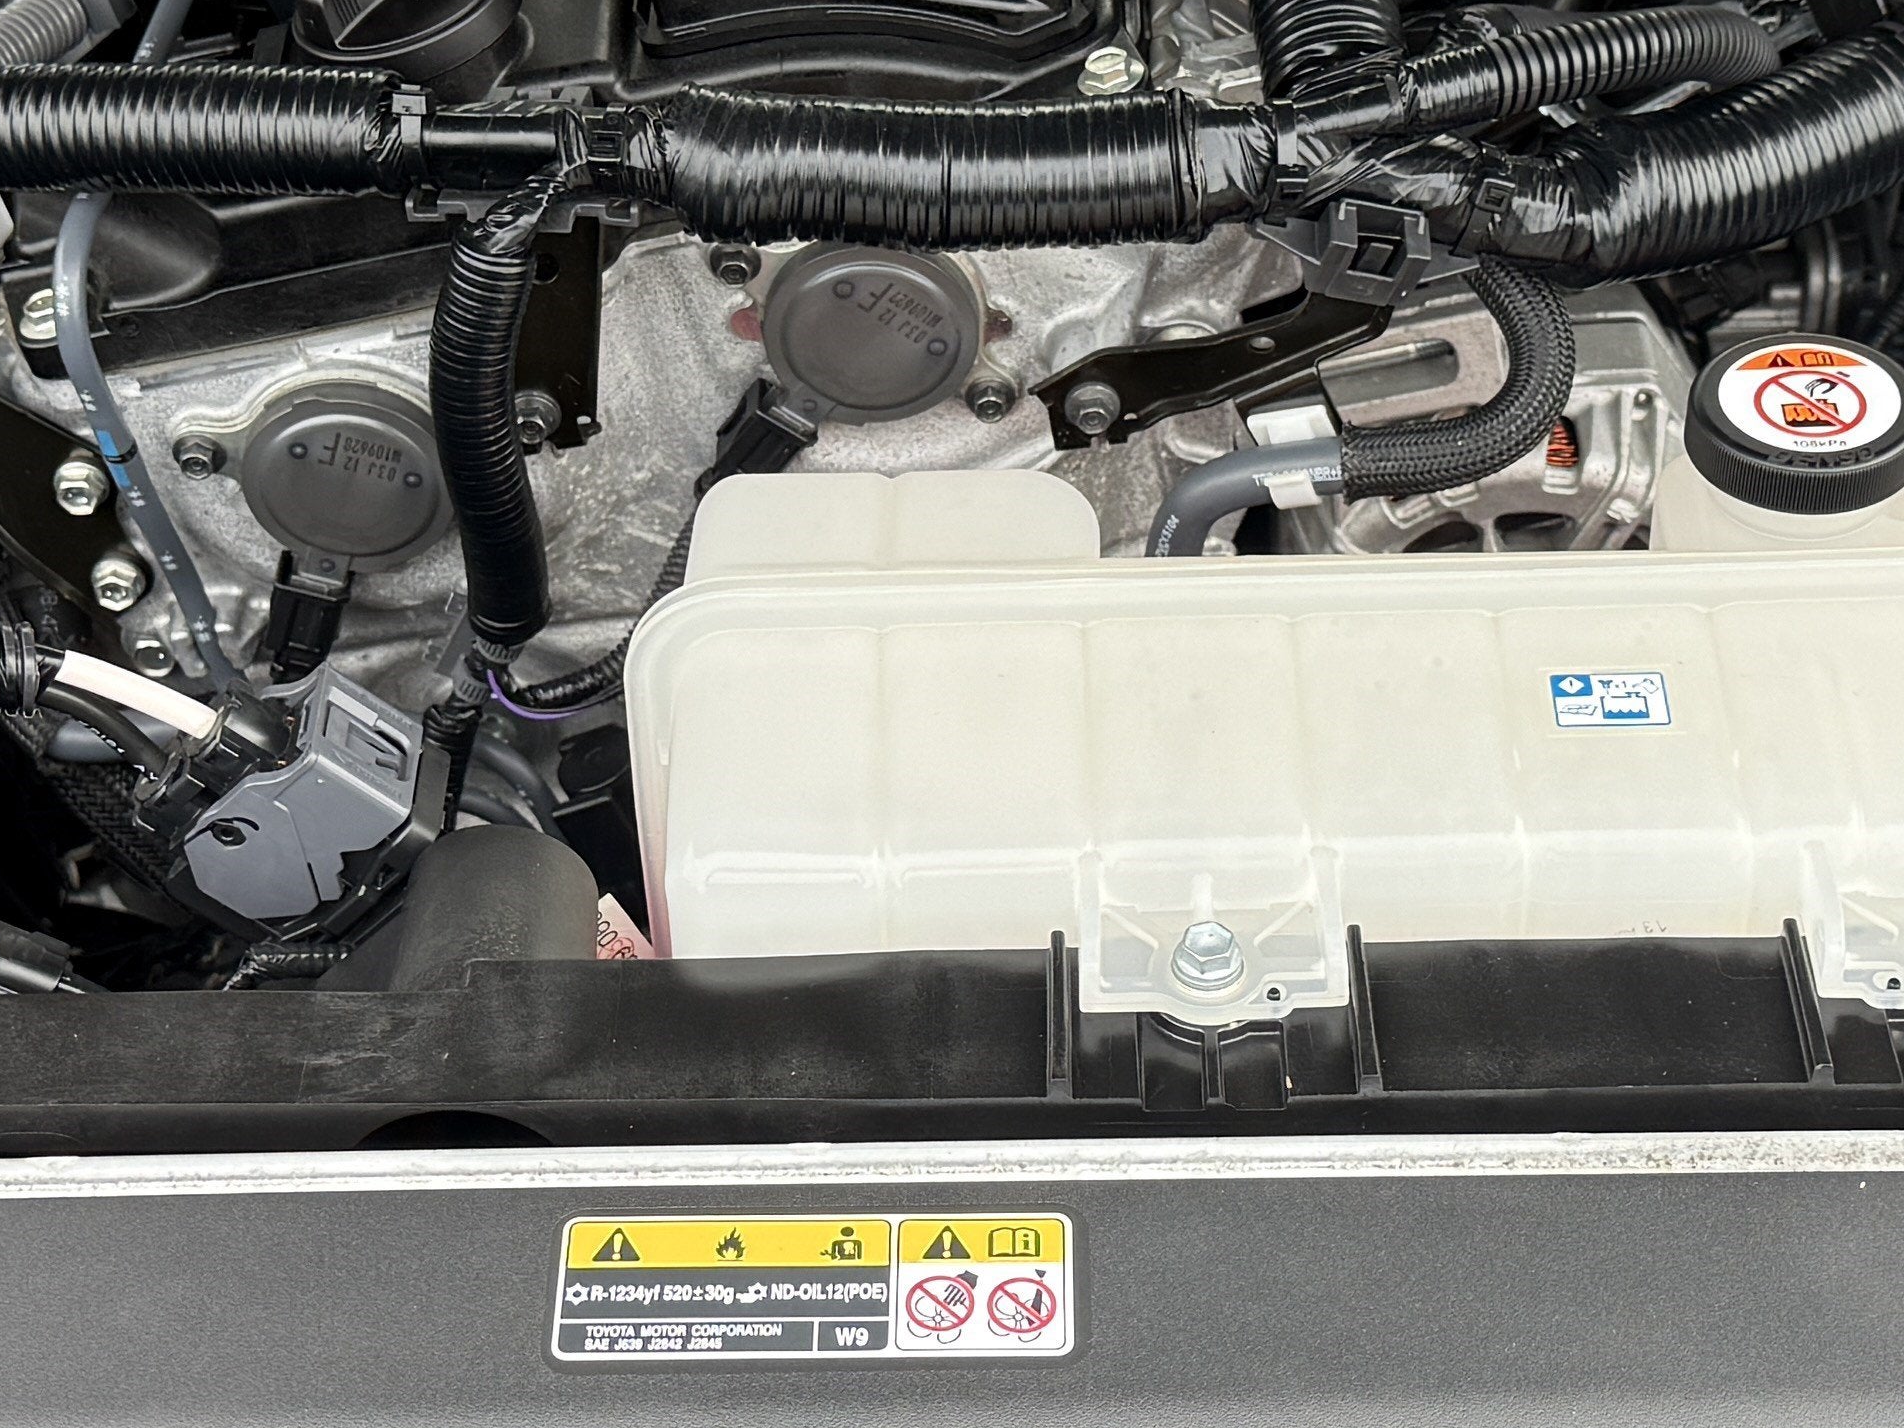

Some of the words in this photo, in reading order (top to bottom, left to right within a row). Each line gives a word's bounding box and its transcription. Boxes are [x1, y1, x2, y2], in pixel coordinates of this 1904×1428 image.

[590, 1283, 660, 1305] R-1234yf
[663, 1283, 735, 1305] 520±30g
[771, 1282, 888, 1304] ND-OIL12(POE)
[585, 1325, 635, 1337] TOYOTA
[641, 1325, 687, 1337] MOTOR
[691, 1323, 783, 1336] CORPORATION
[835, 1327, 869, 1347] W9
[584, 1338, 609, 1351] SAE
[614, 1338, 644, 1350] J639
